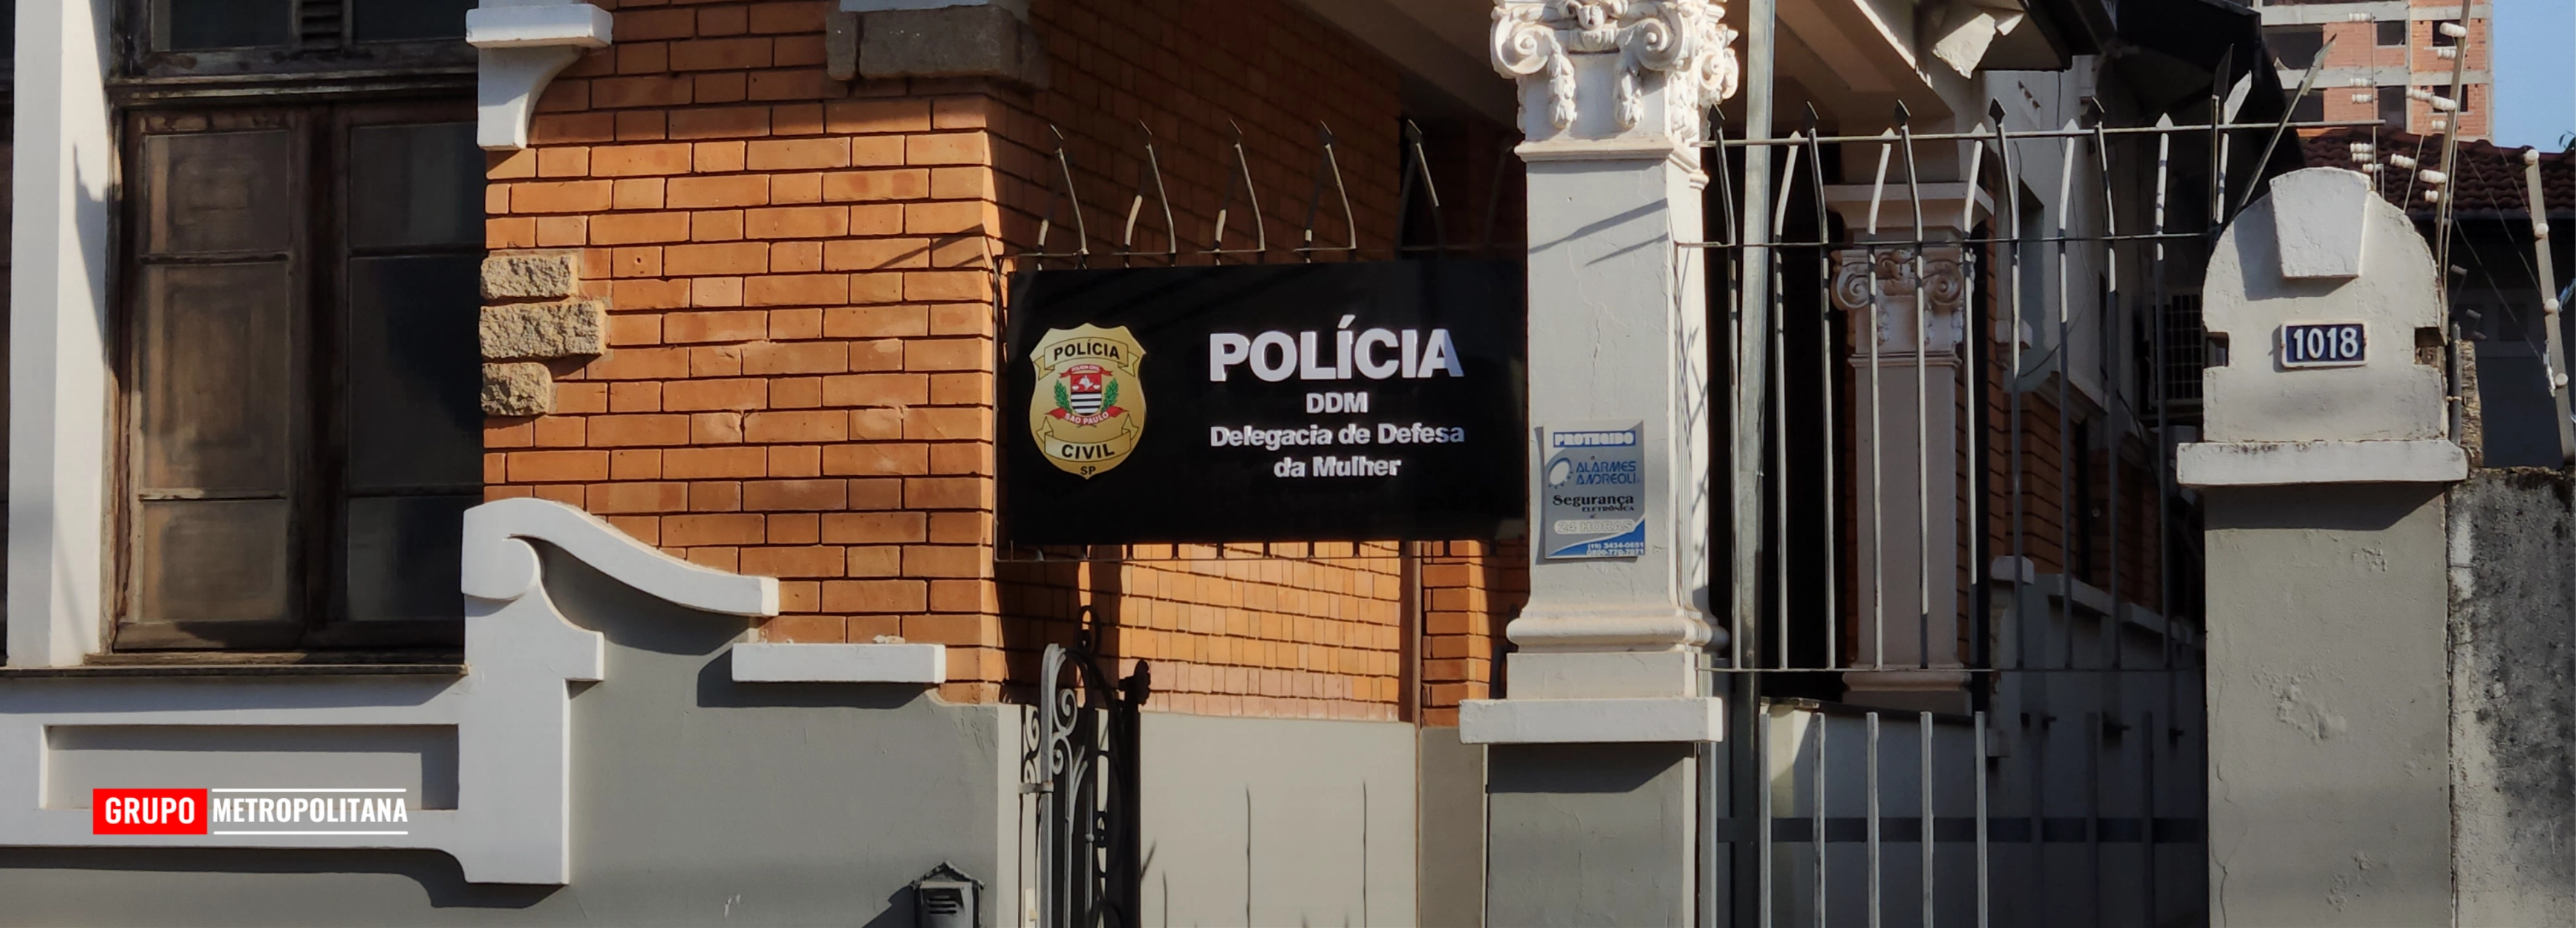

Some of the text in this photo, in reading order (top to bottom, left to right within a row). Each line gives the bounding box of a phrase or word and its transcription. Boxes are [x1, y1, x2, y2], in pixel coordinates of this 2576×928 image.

[1054, 339, 1120, 361] POLÍCIA
[1210, 314, 1464, 382] POLÍCIA
[2293, 327, 2358, 360] 1018
[1306, 392, 1368, 413] DDM
[1083, 411, 1109, 425] PAULO
[1210, 422, 1464, 451] Delegacia de Defesa
[1554, 432, 1634, 445] PROTEGIDO
[1061, 443, 1115, 460] CIVIL
[1080, 466, 1096, 476] SP
[1274, 455, 1401, 477] da Mulher
[1576, 461, 1636, 473] ALARMES
[1576, 473, 1636, 485] ANDREOLI
[1553, 494, 1634, 508] Segurança
[1558, 520, 1632, 532] 24 HORAS
